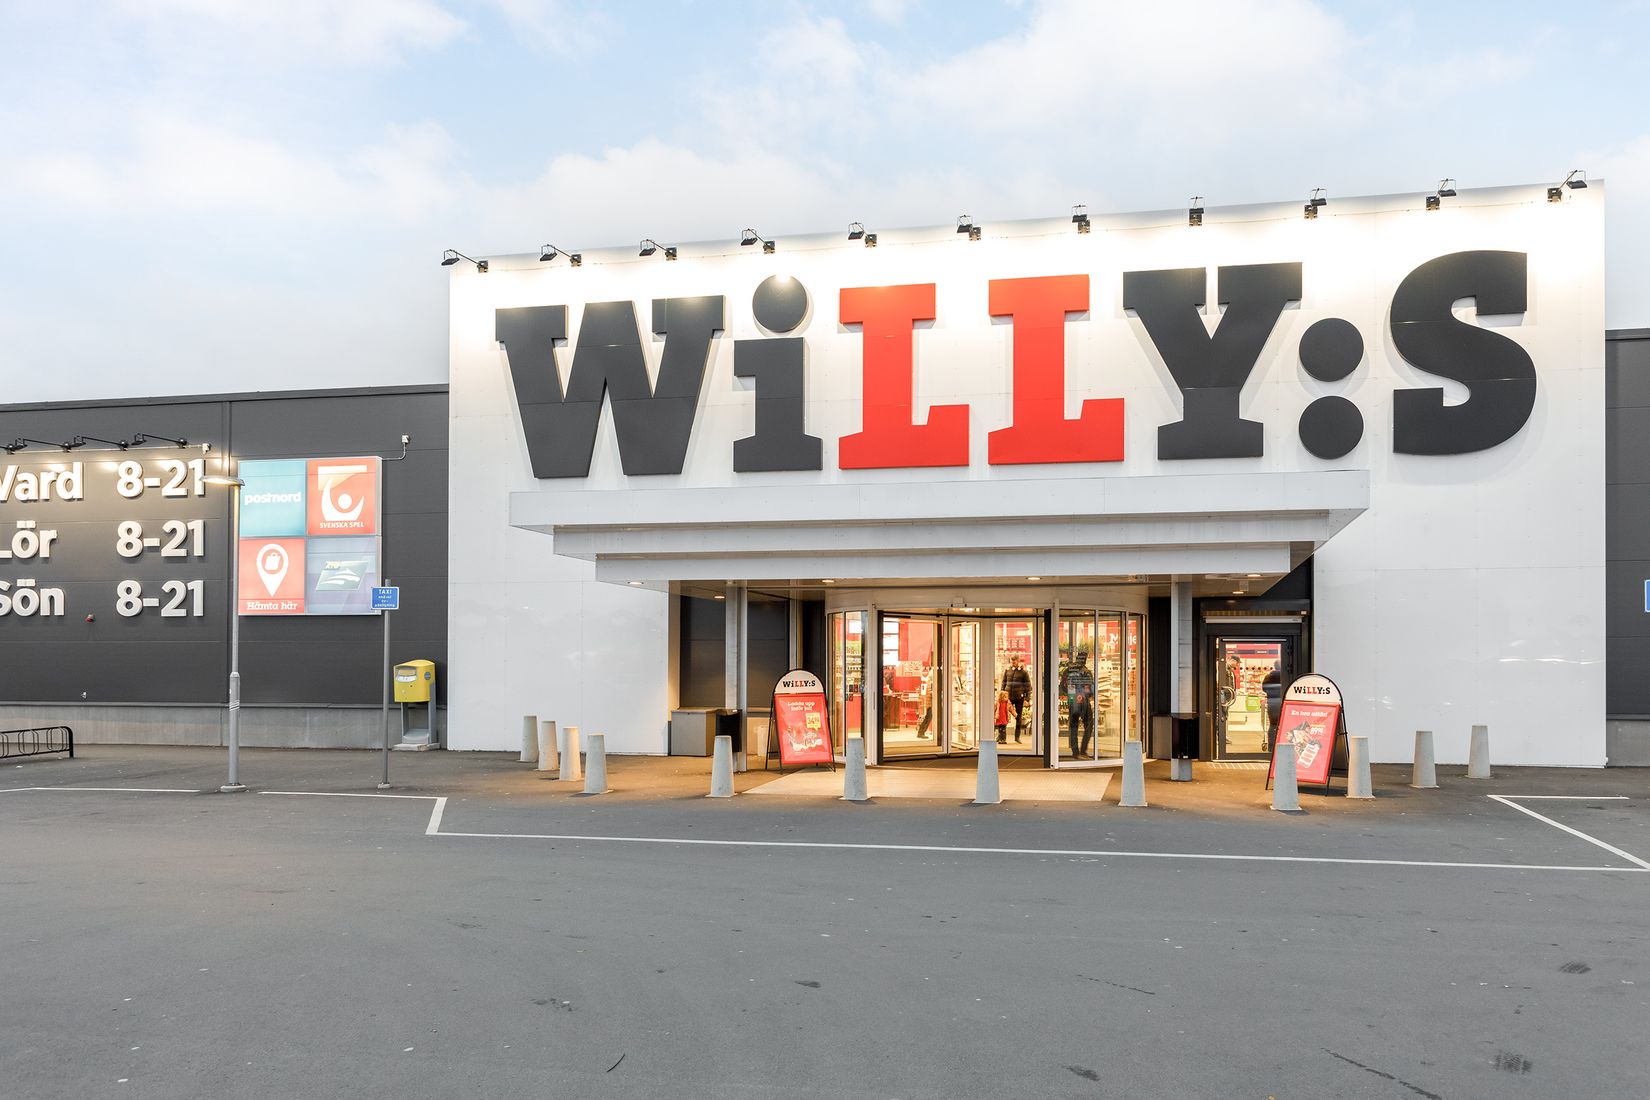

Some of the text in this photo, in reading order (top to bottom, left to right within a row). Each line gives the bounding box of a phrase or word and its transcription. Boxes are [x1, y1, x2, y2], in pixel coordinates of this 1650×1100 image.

[495, 250, 1537, 479] WiLLY:S
[116, 459, 205, 497] 8-21
[244, 491, 302, 506] postnord
[116, 520, 204, 557] 8-21
[116, 580, 204, 617] 8-21
[246, 601, 298, 610] Hämta här
[783, 680, 815, 688] WiLLY:S
[1293, 686, 1331, 695] WiLLY:S
